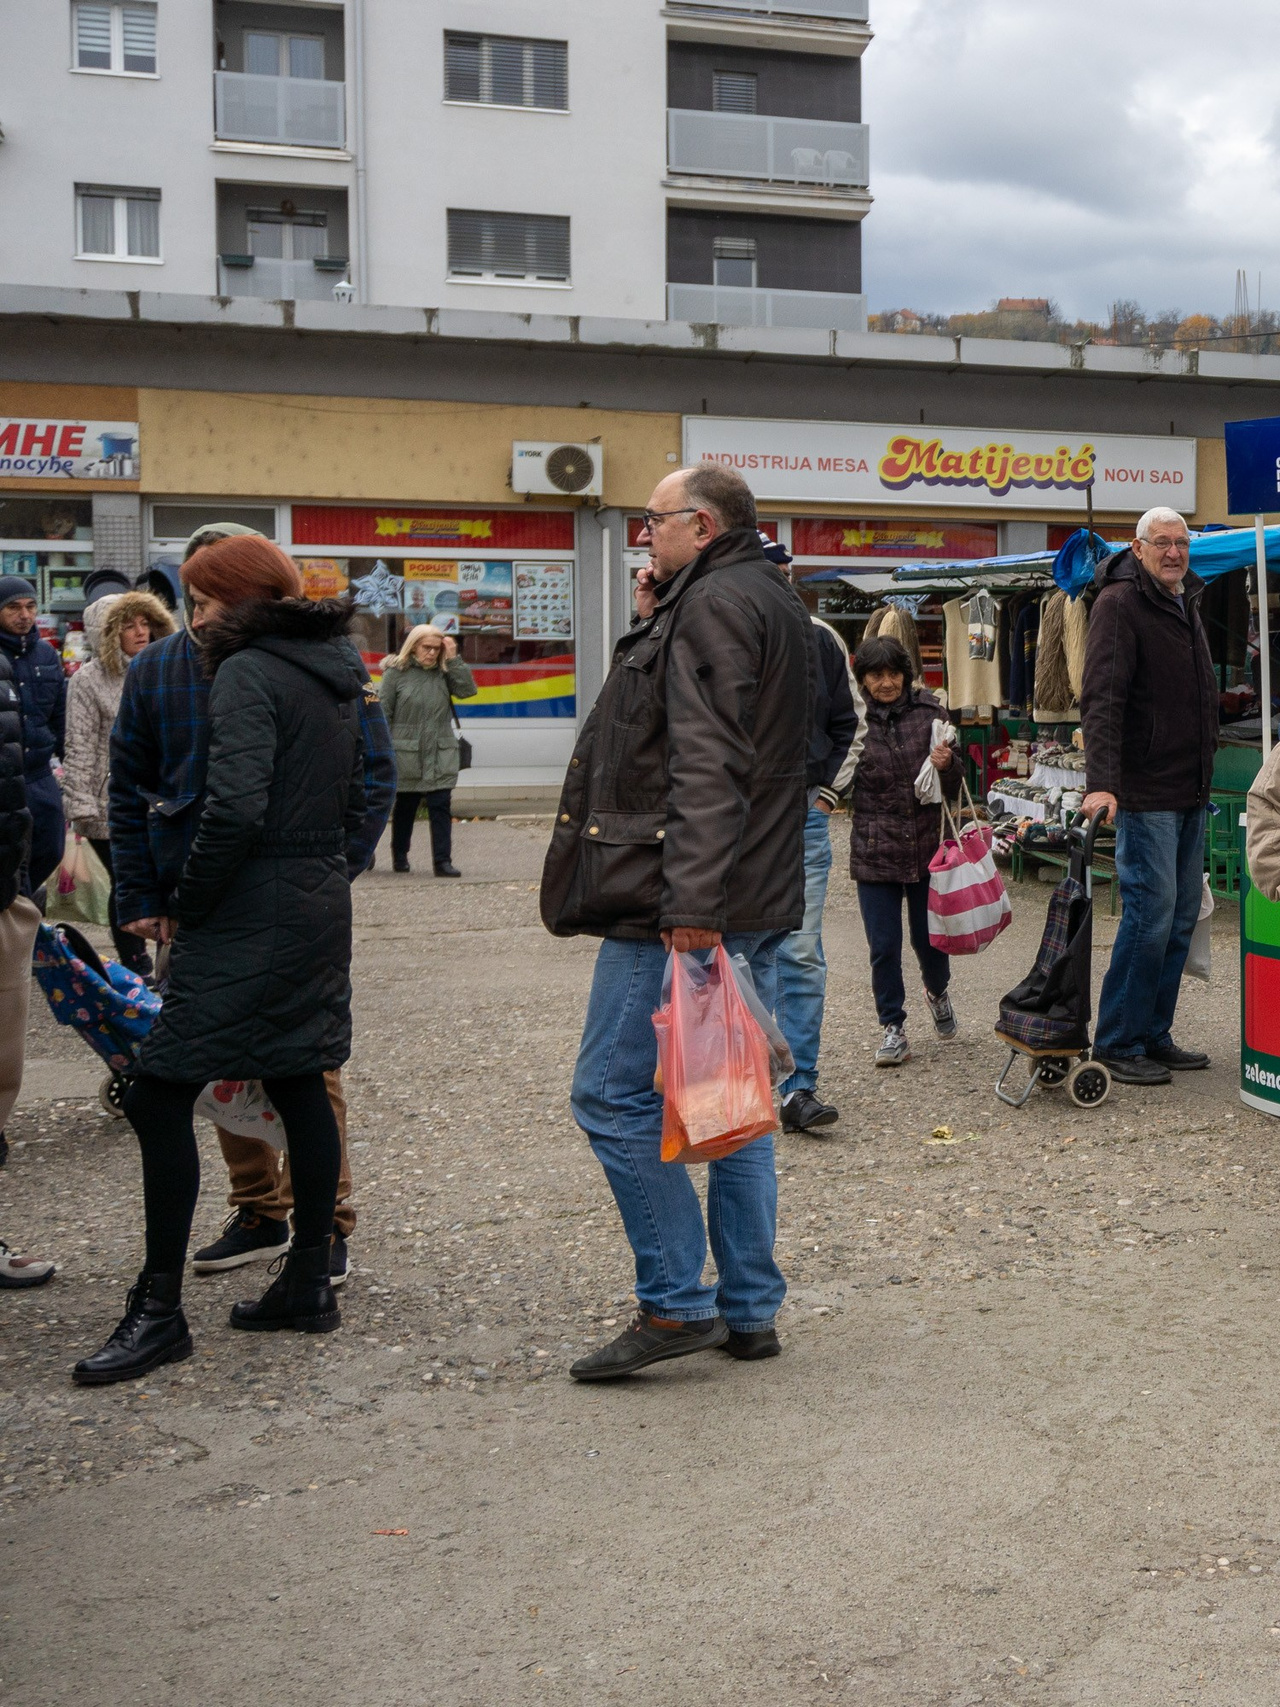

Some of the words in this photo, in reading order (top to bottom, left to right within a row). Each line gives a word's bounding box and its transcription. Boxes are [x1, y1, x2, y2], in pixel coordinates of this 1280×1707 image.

[0, 423, 87, 457] ИНЕ
[524, 450, 542, 458] YORK
[817, 456, 869, 473] MESA
[879, 436, 1096, 494] Matijević
[1104, 468, 1145, 483] NOVI
[1150, 469, 1184, 484] SAD
[409, 563, 455, 572] POPUST
